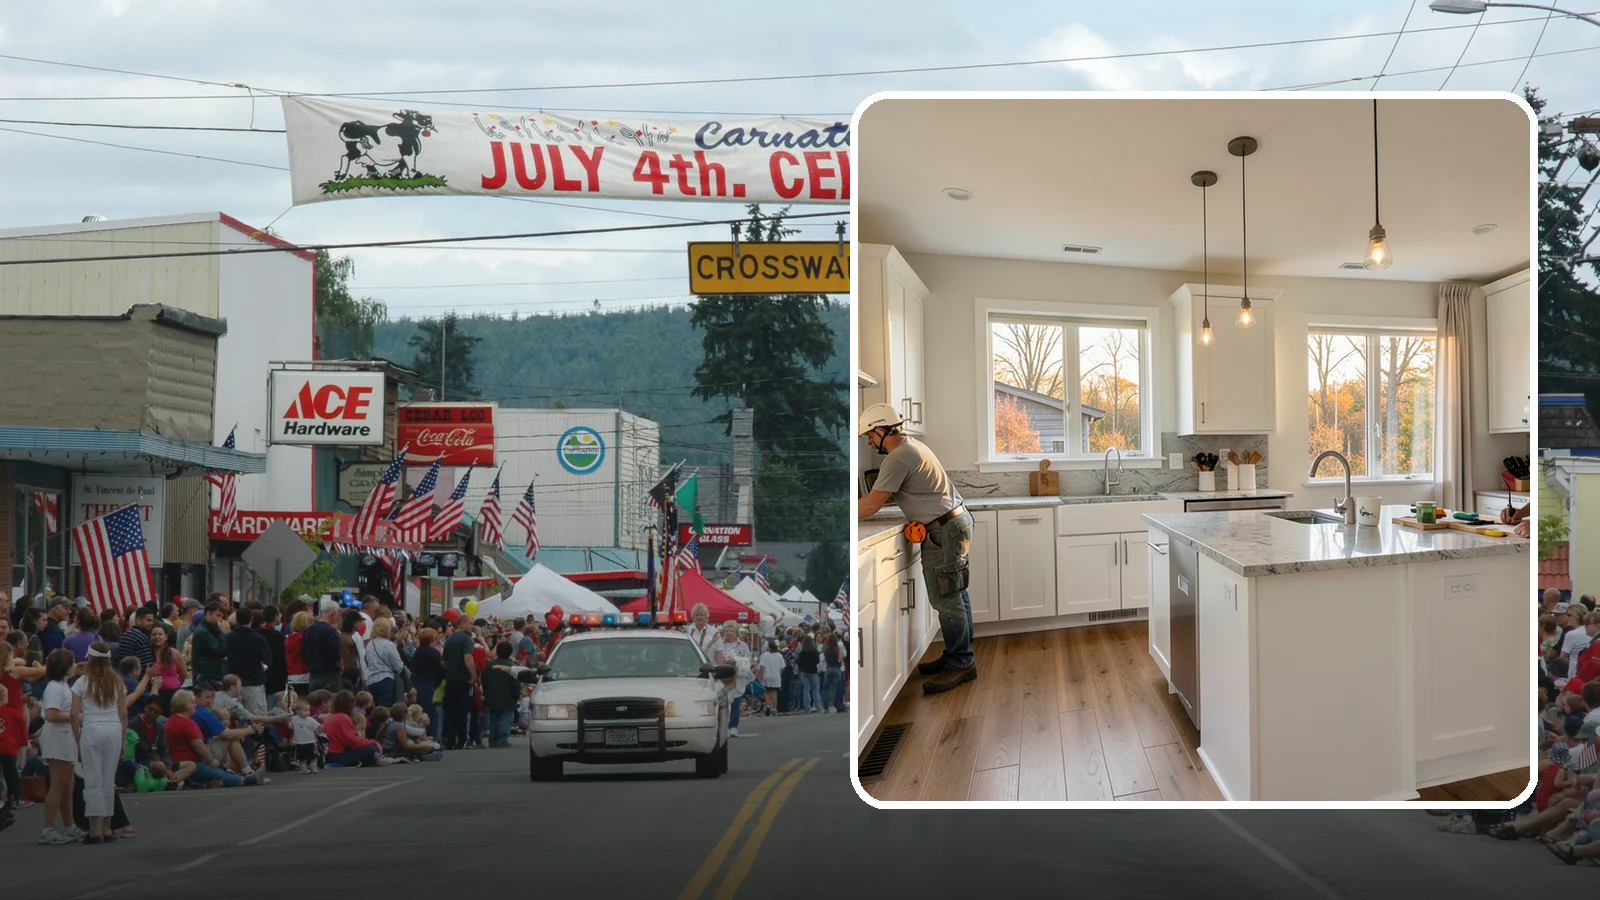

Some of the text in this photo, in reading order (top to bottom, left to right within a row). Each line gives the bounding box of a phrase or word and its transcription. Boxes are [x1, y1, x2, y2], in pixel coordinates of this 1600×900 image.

[481, 141, 604, 192] JULY
[632, 149, 746, 197] 4th.
[696, 254, 850, 280] CROSSWA
[282, 380, 374, 420] ACE
[406, 409, 453, 422] CEDAR
[283, 421, 371, 437] Hardware
[83, 484, 155, 495] St. Vincent de Paul
[688, 526, 741, 535] CRNATION
[699, 535, 730, 543] GLASS
